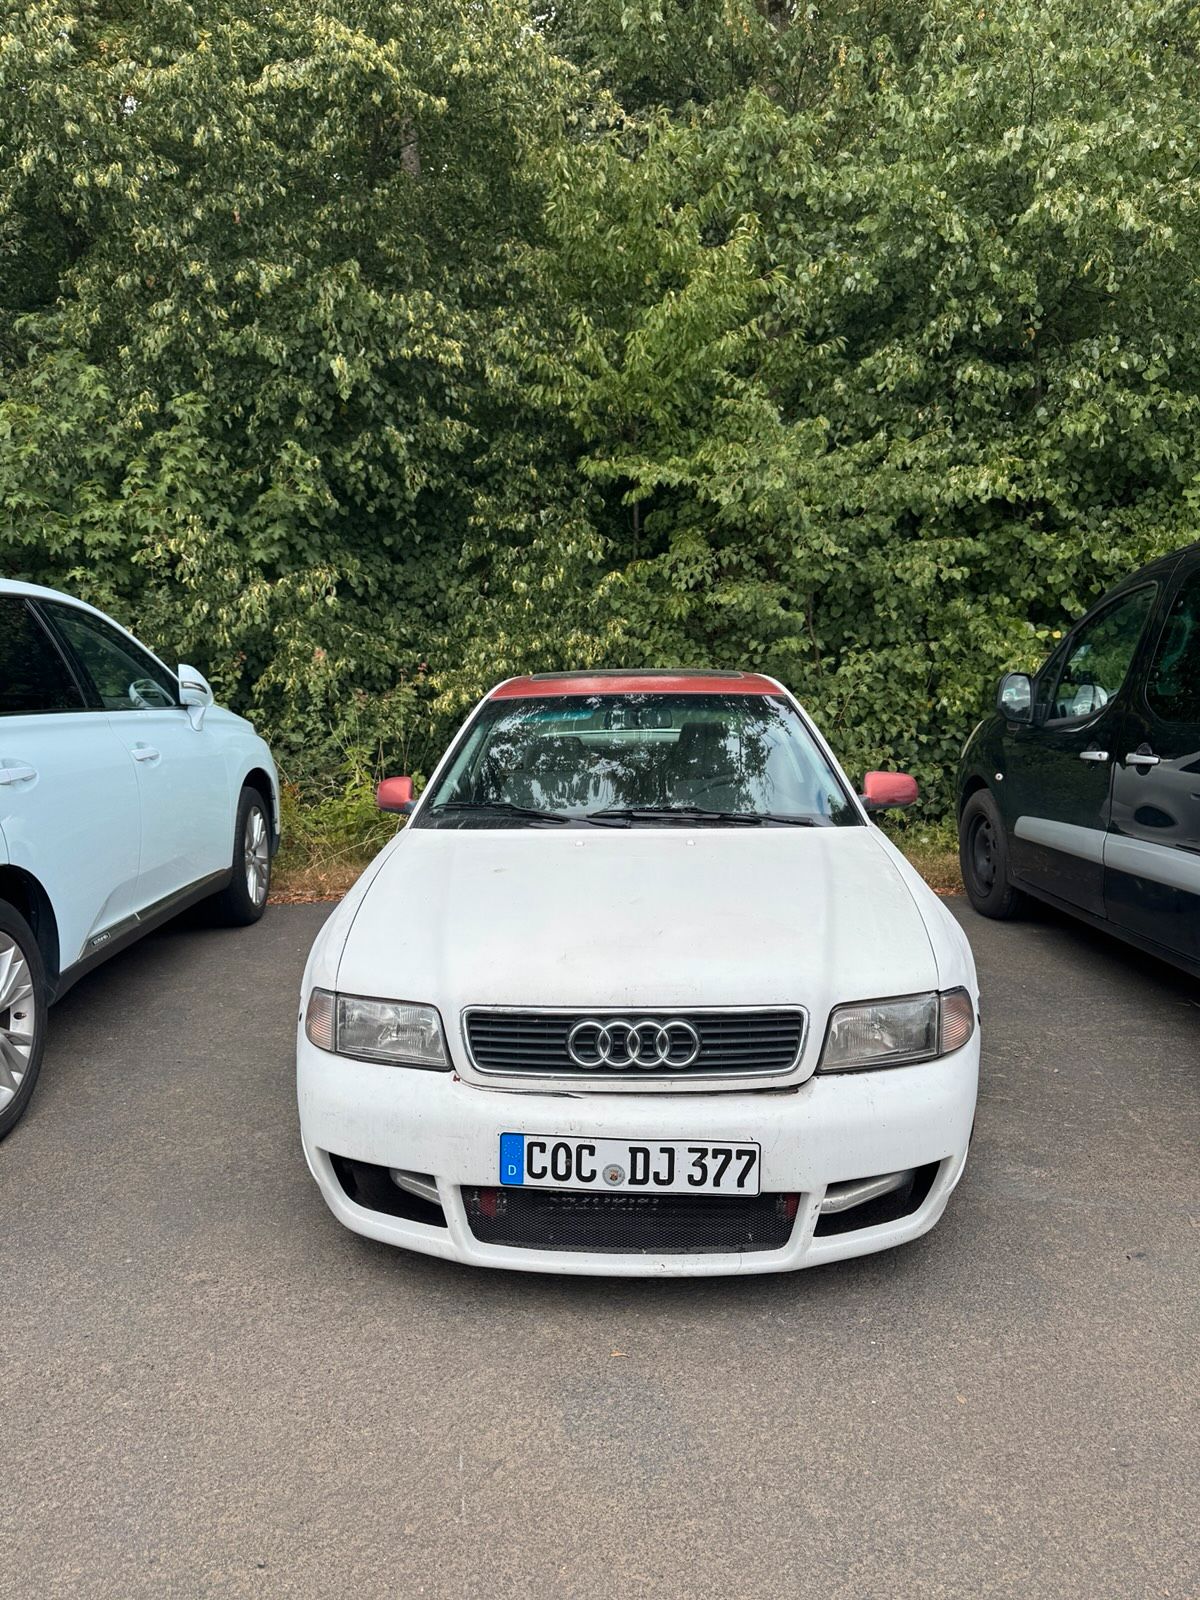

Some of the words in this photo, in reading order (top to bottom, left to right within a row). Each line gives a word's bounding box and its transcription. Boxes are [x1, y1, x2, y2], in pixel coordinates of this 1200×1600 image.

[508, 1165, 516, 1175] D
[527, 1141, 597, 1182] COC
[628, 1146, 675, 1186] DJ
[687, 1147, 757, 1188] 377
